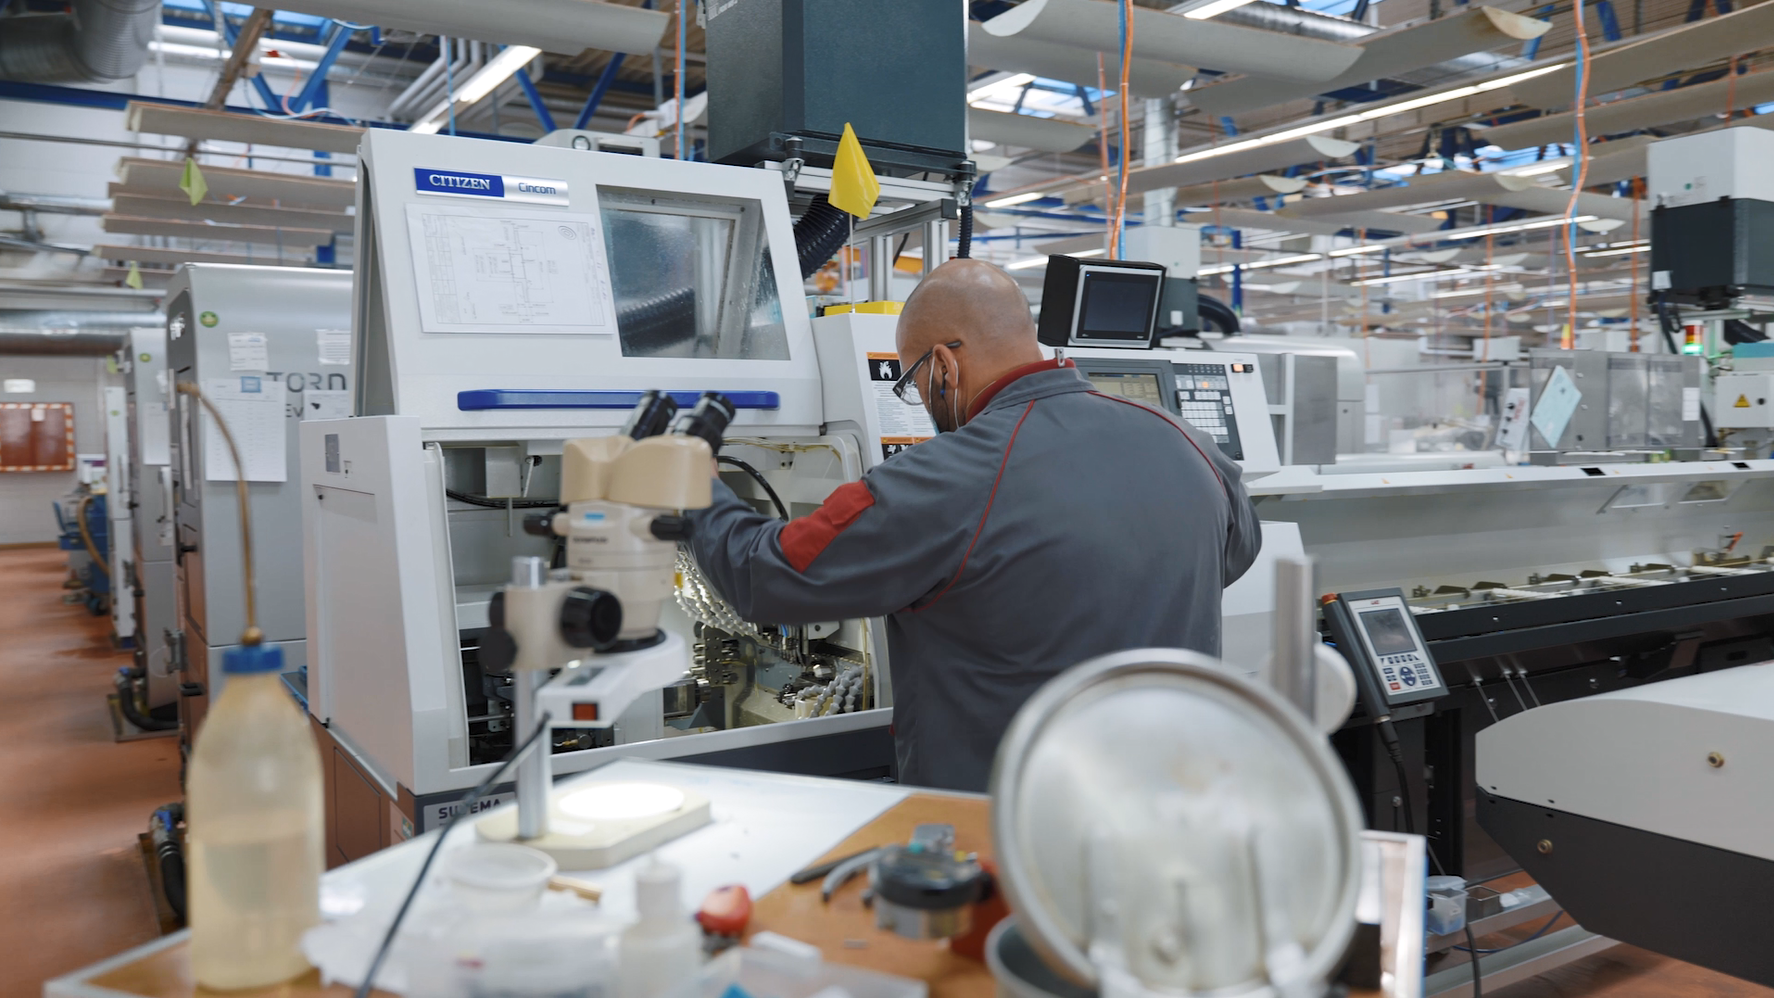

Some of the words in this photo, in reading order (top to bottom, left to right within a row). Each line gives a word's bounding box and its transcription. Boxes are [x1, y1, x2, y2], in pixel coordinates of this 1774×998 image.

[429, 174, 491, 190] CITIZEN
[518, 182, 556, 195] Cincom
[438, 798, 501, 819] SUEMA
